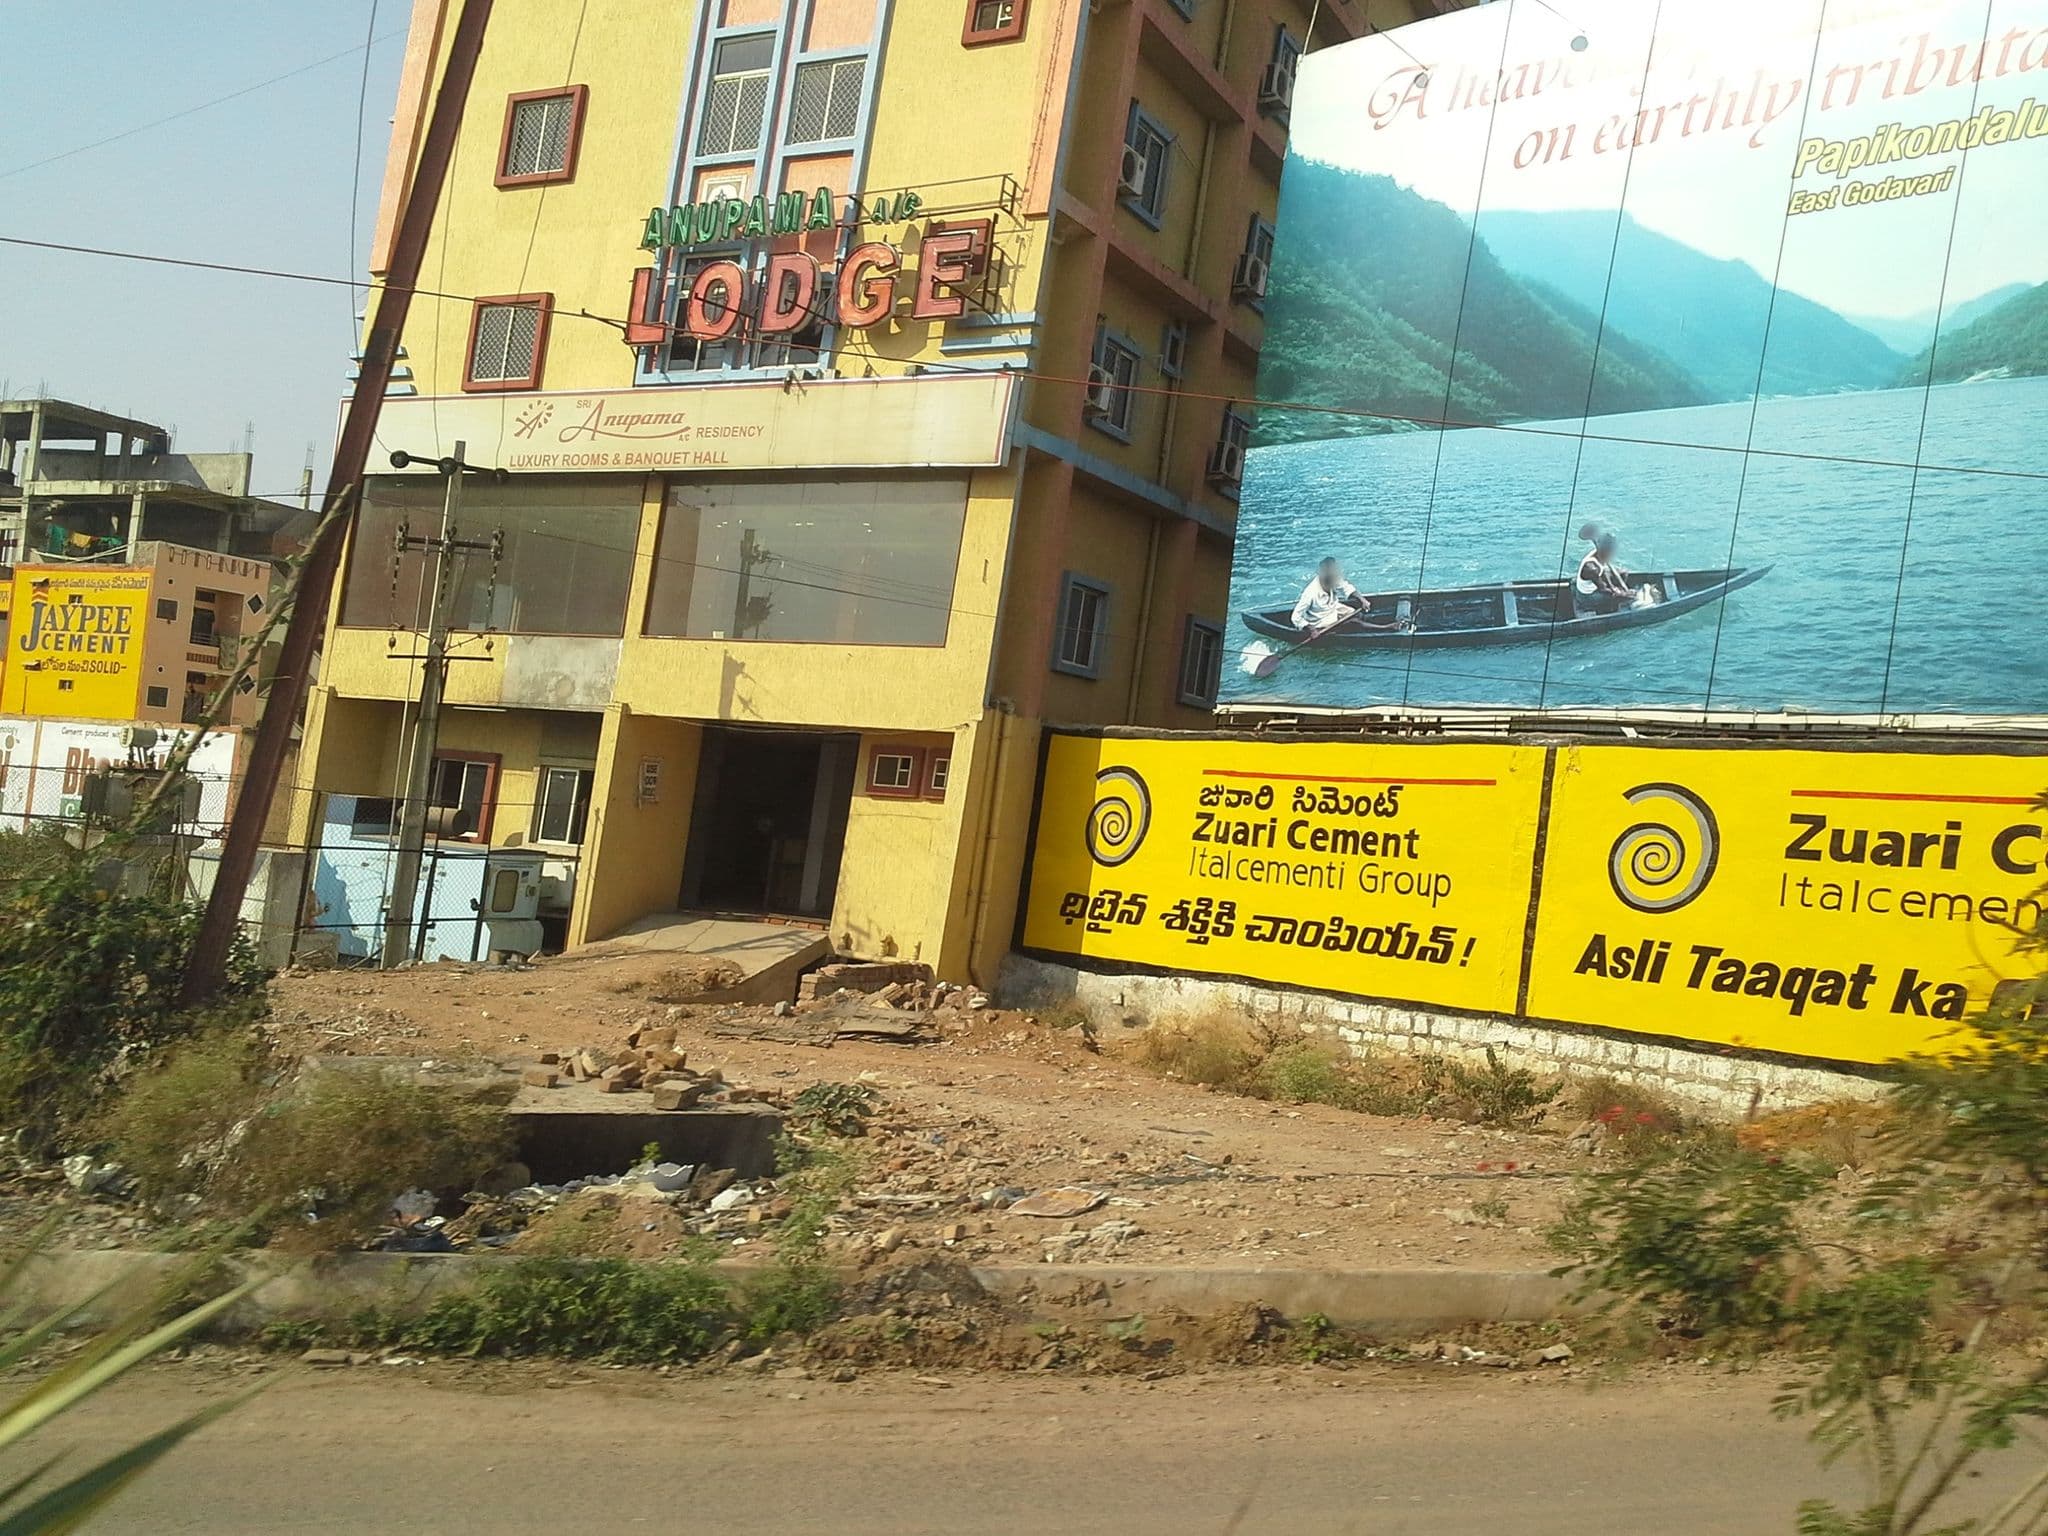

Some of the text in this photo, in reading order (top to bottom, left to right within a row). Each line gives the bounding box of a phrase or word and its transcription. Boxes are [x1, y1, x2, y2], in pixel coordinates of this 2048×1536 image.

[1368, 64, 1437, 130] A
[1513, 123, 1576, 169] on
[1592, 67, 1803, 154] earthly
[1791, 97, 2048, 179] Papikondalu
[1787, 166, 1956, 215] East Godavari
[640, 186, 922, 248] ANUPAMA A/C
[624, 229, 978, 347] LODGE
[559, 399, 691, 443] Anupama
[576, 400, 591, 409] SRI
[696, 426, 765, 438] RESIDENCY
[509, 451, 729, 467] LUXURY ROOMS & BANQUET HALL
[20, 601, 132, 651] JAYPEE
[41, 633, 129, 654] CEMENT
[1199, 784, 1404, 818] జువారి సిమెంట్
[1192, 812, 1420, 860] Zuari Cement
[1784, 813, 1962, 870] Zuari
[1189, 847, 1452, 908] Italcementi Group
[1159, 896, 1237, 945] శక్తికి
[1573, 934, 1672, 984] Asli
[1686, 945, 1877, 1017] Taaqat
[1889, 968, 1967, 1021] ka
